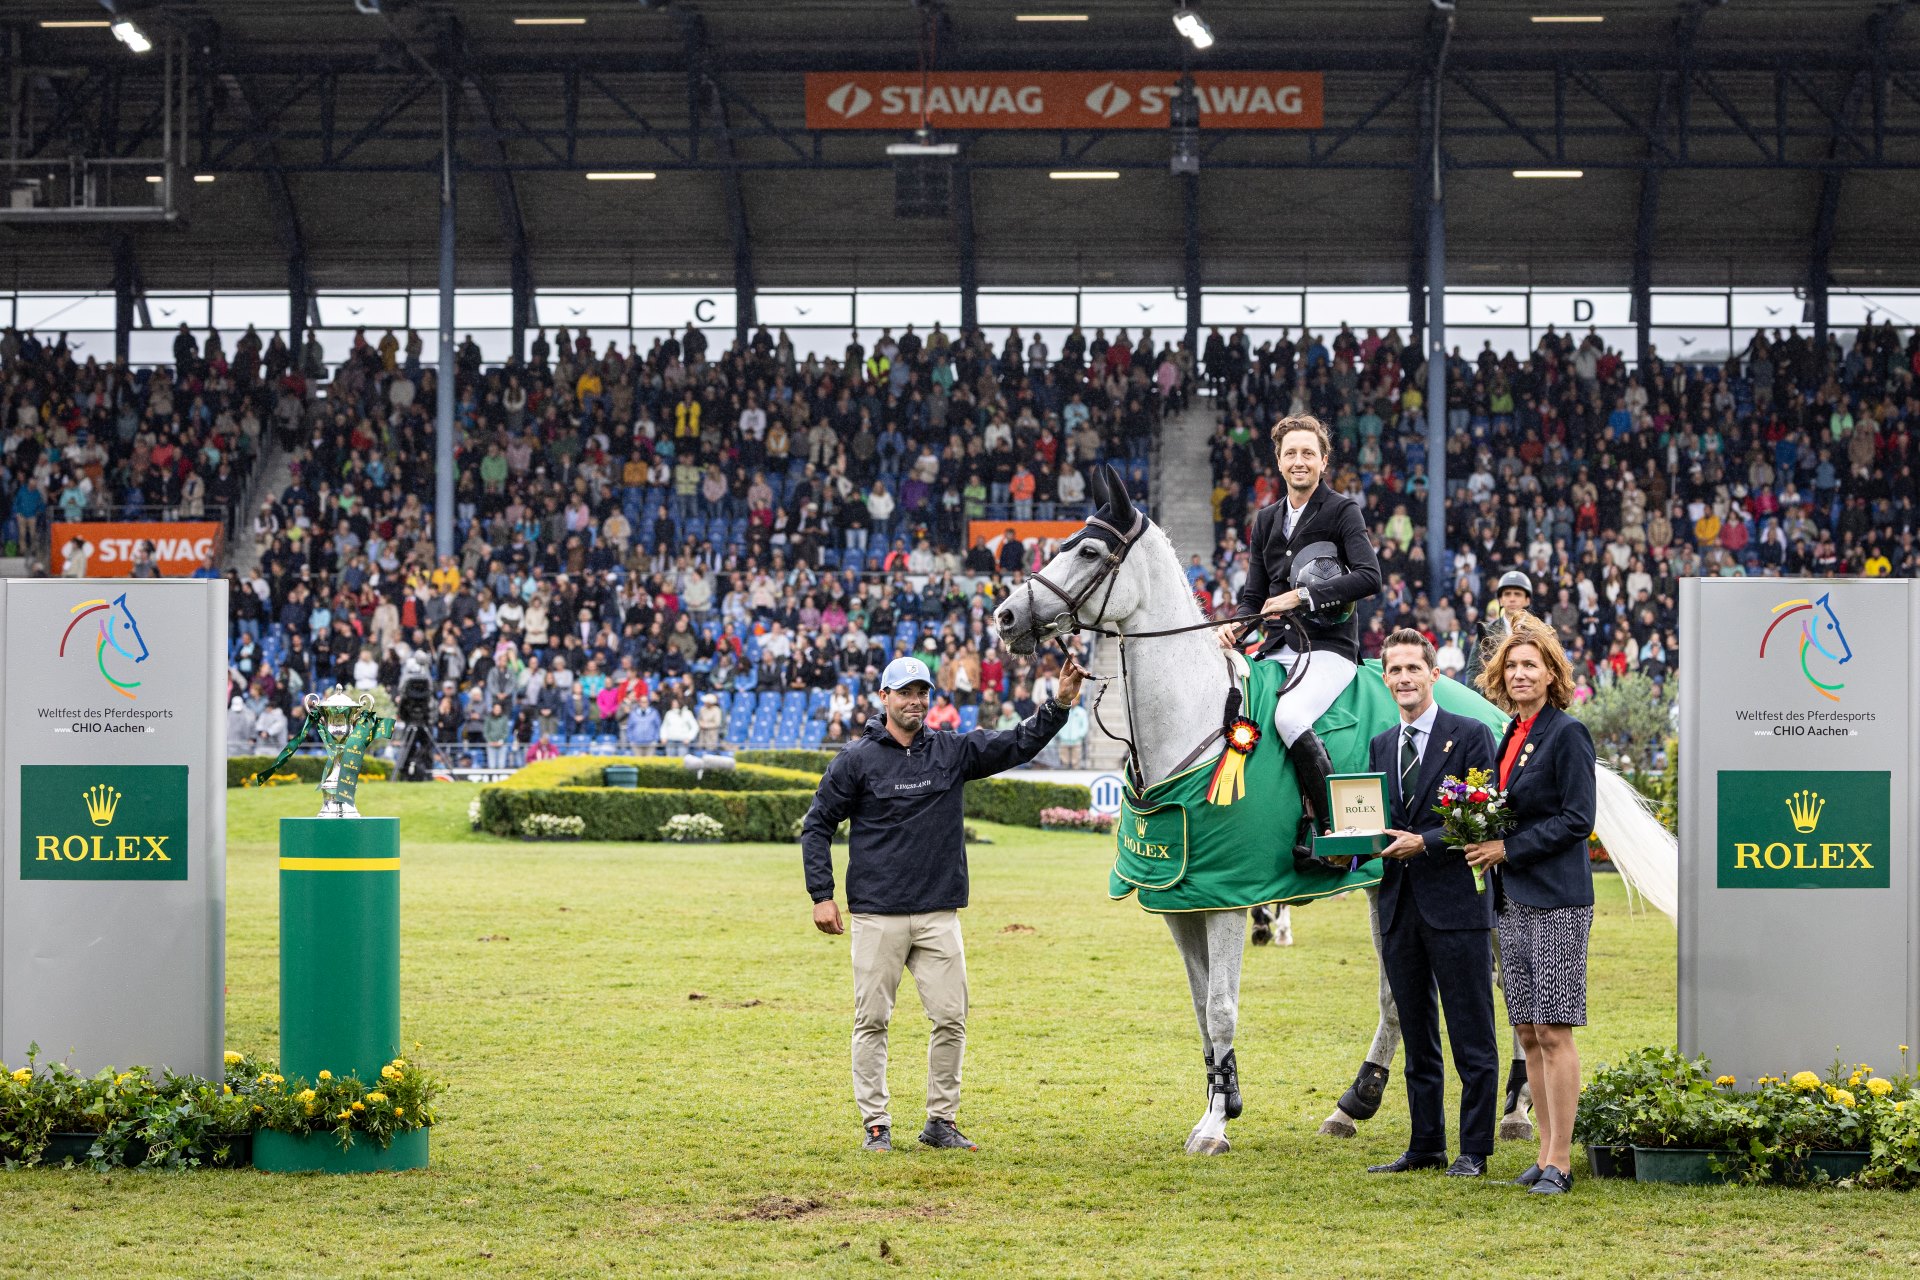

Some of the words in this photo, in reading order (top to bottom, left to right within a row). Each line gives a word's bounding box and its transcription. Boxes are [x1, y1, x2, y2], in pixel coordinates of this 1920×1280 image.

[880, 86, 1044, 114] STAWAG
[695, 299, 715, 322] C
[1574, 299, 1594, 322] D
[37, 708, 82, 718] Weltfest
[83, 708, 102, 718] des
[104, 708, 173, 720] Pferdesports
[1735, 710, 1783, 721] Weltfest
[1785, 710, 1805, 721] des
[1807, 710, 1876, 723] Pferdesports
[1345, 805, 1376, 813] ROLEX
[35, 835, 172, 862] ROLEX
[1734, 842, 1874, 870] ROLEX
